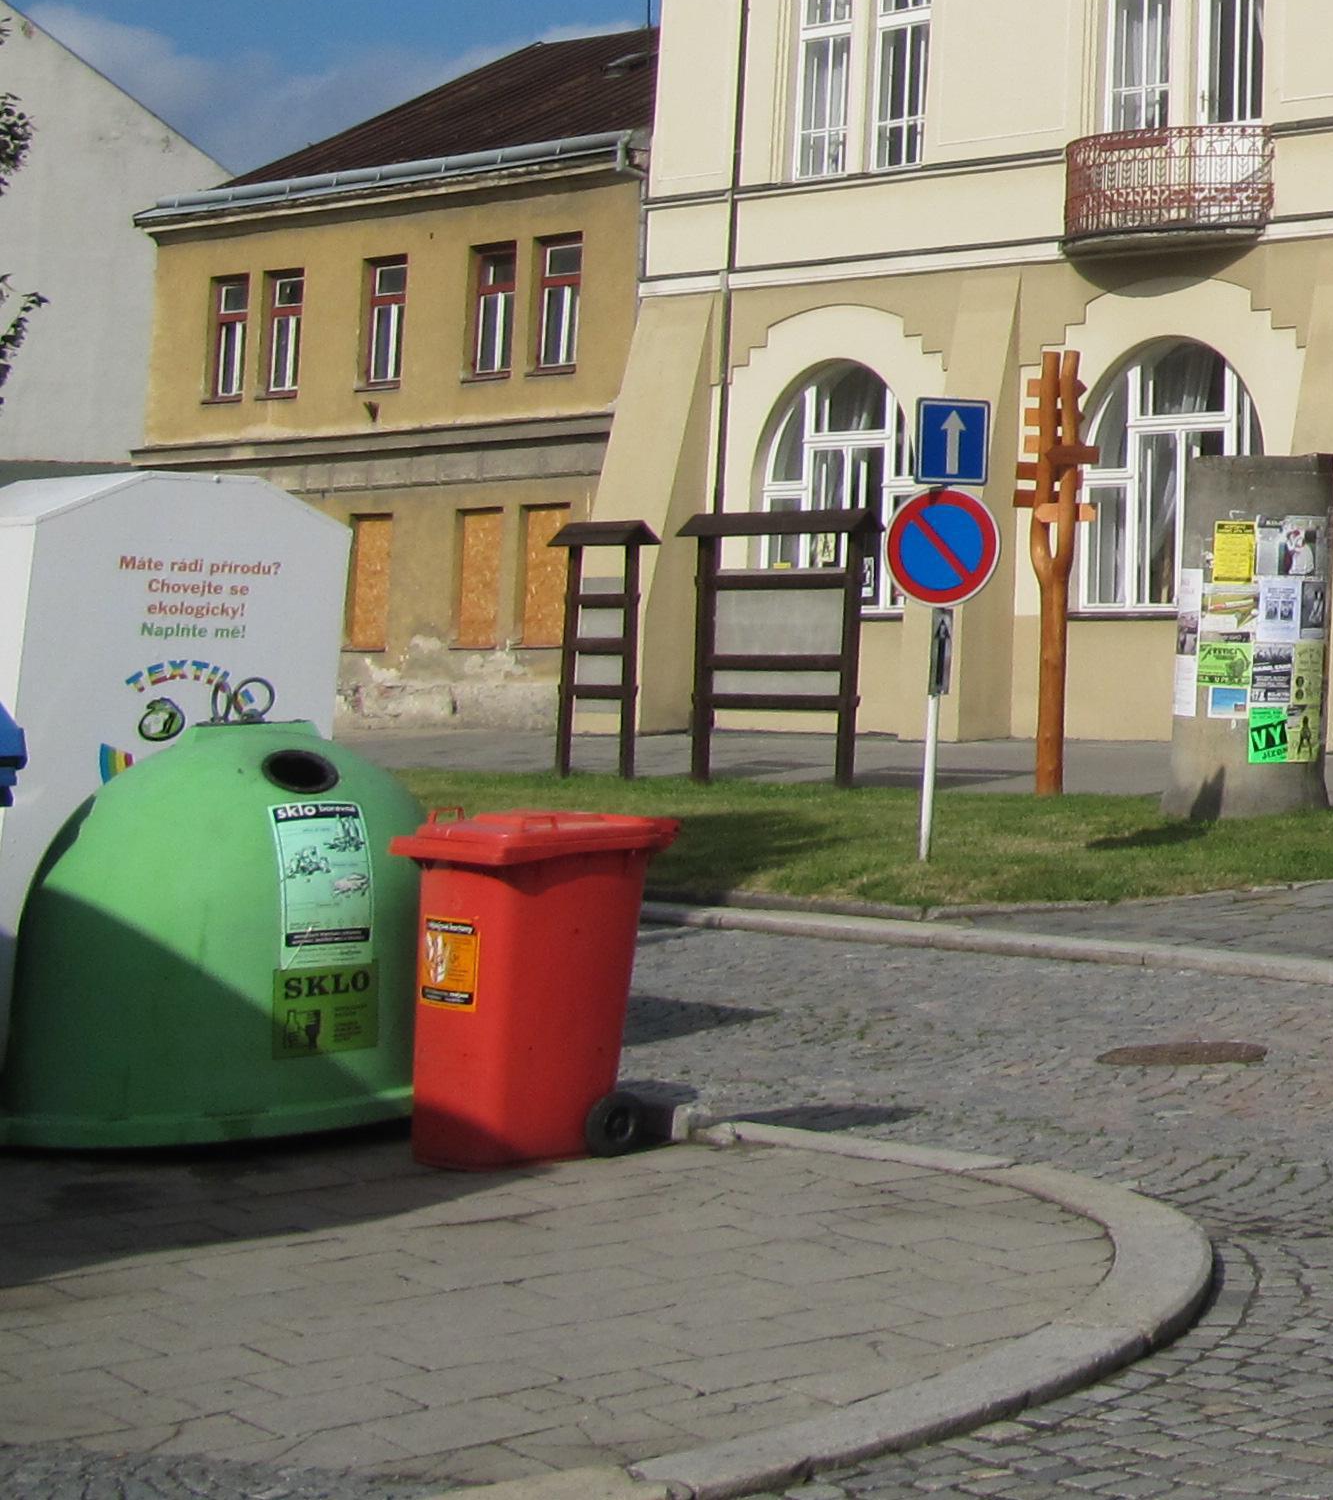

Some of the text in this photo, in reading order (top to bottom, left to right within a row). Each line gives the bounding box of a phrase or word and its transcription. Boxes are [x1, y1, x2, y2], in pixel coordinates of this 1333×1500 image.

[118, 555, 282, 576] Máte rádi přírodu?
[147, 578, 250, 597] Chovejte se
[146, 601, 246, 619] ekologicky!
[140, 621, 207, 640] Naplňte
[276, 803, 317, 820] sklo
[284, 970, 370, 1000] SKLO
